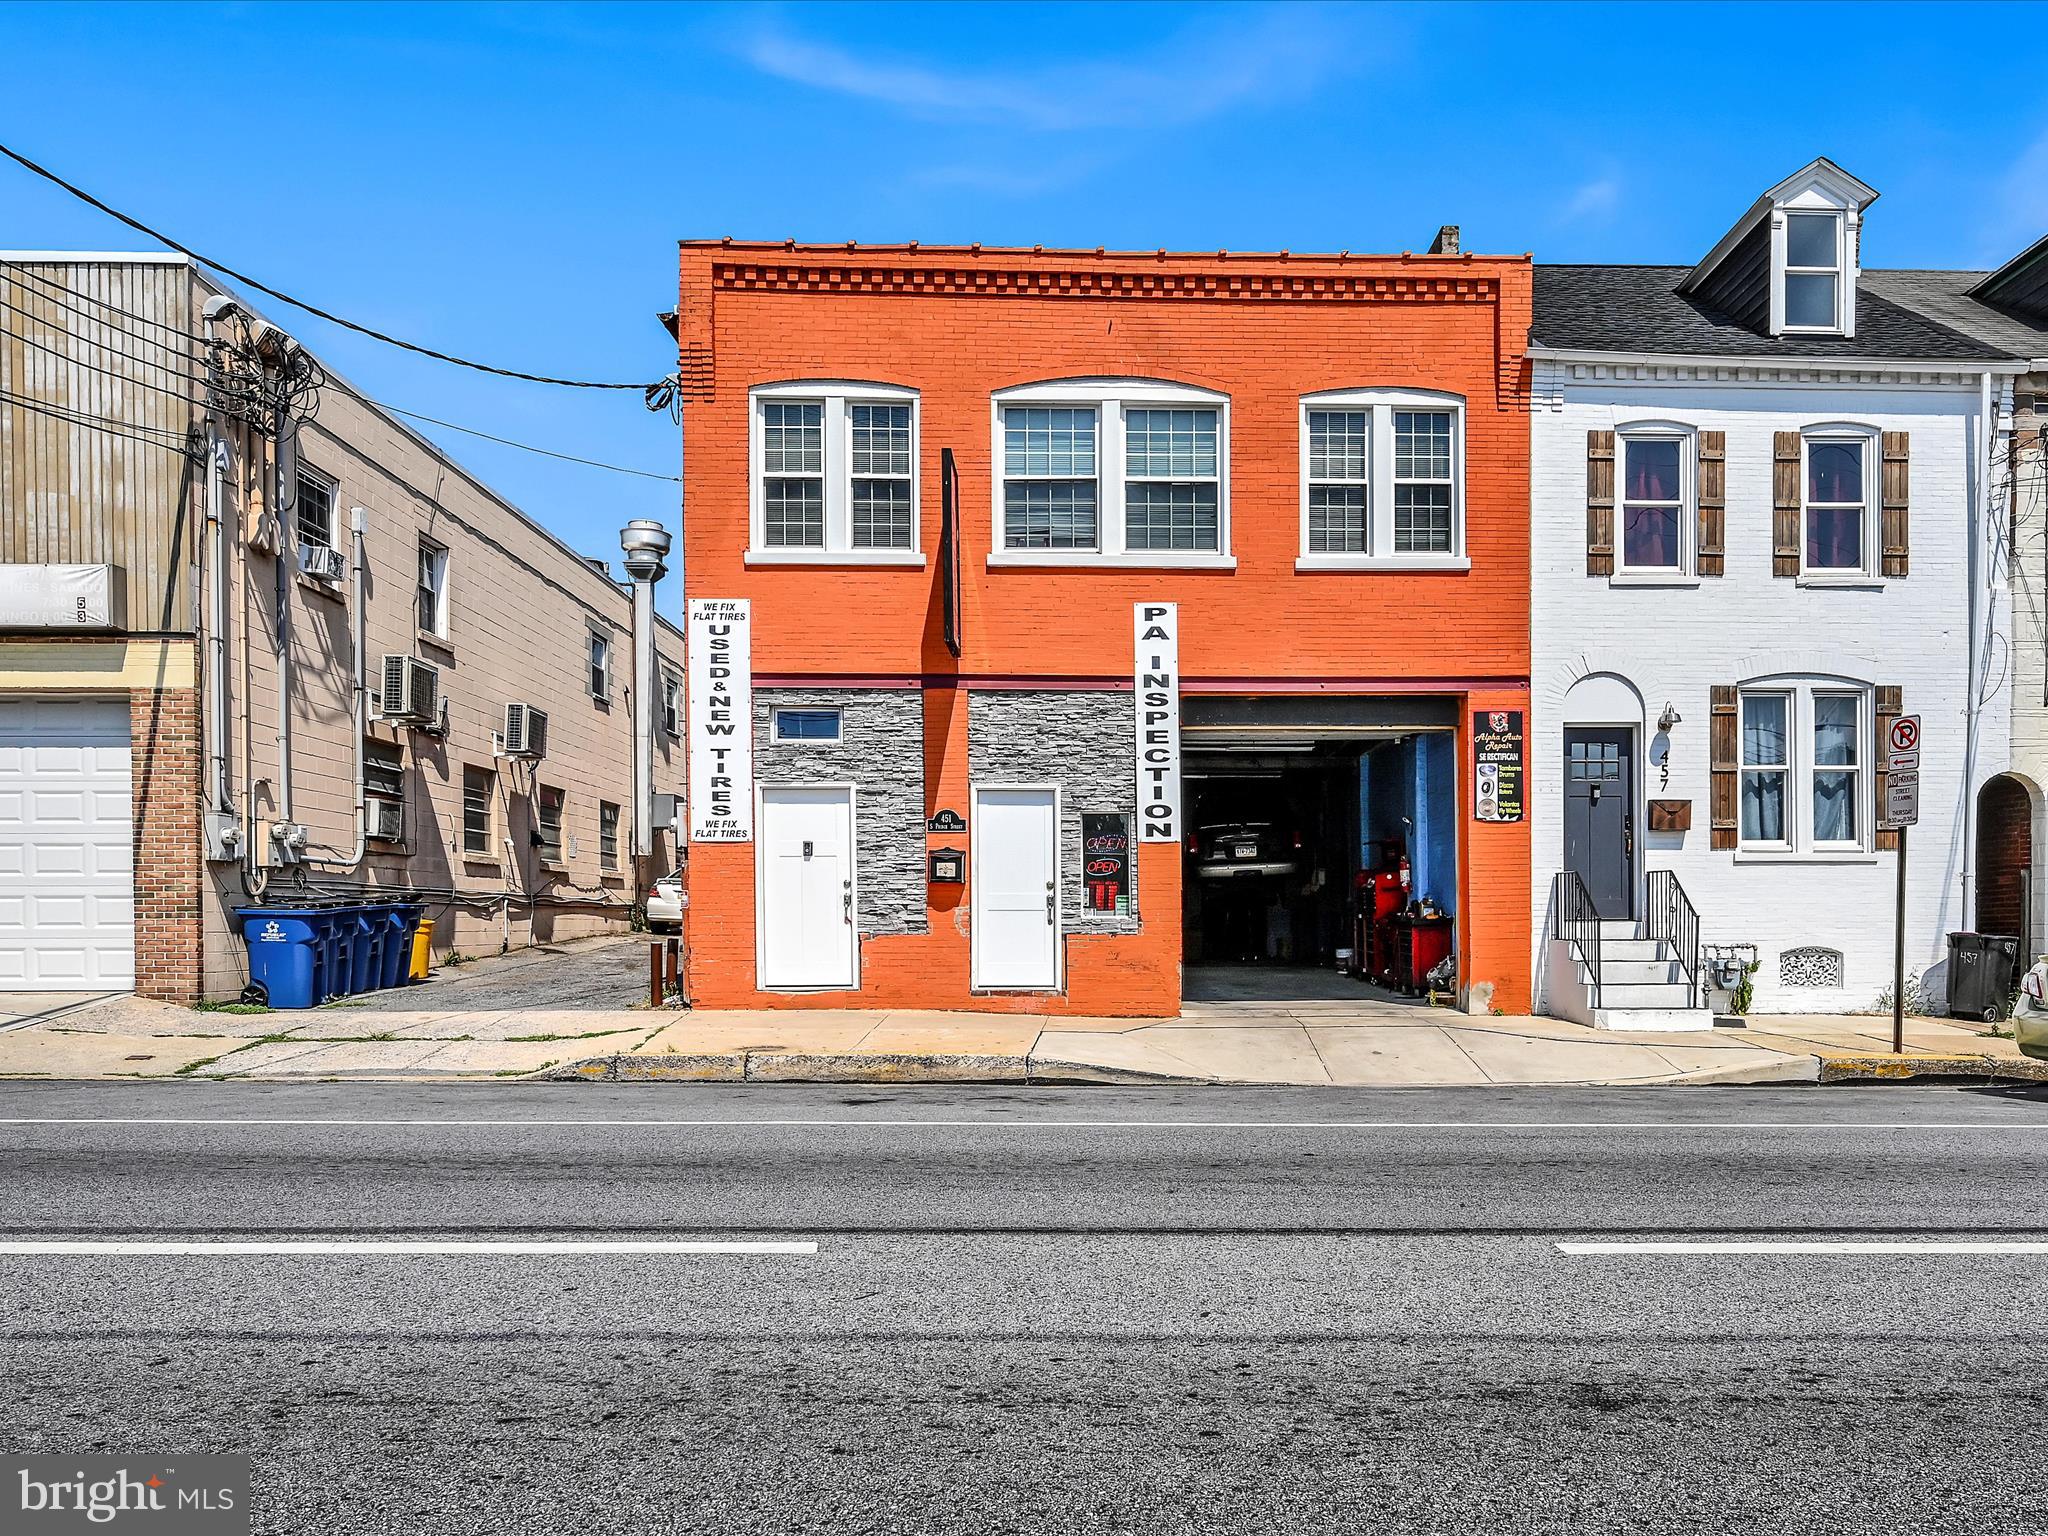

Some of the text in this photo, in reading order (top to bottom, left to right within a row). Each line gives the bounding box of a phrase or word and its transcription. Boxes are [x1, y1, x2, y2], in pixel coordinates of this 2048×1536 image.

[704, 603, 735, 611] WE FIX
[1141, 607, 1173, 837] PA INSPECTION
[1474, 732, 1522, 743] Alpha Auto
[1485, 741, 1512, 751] Repair
[1479, 752, 1486, 761] SE
[1660, 750, 1668, 792] 457
[709, 748, 732, 816] TIRES
[1888, 775, 1898, 787] NO
[941, 813, 952, 823] 451
[1087, 837, 1127, 850] OPEN
[1087, 861, 1119, 873] OPEN
[1960, 951, 1978, 966] 457
